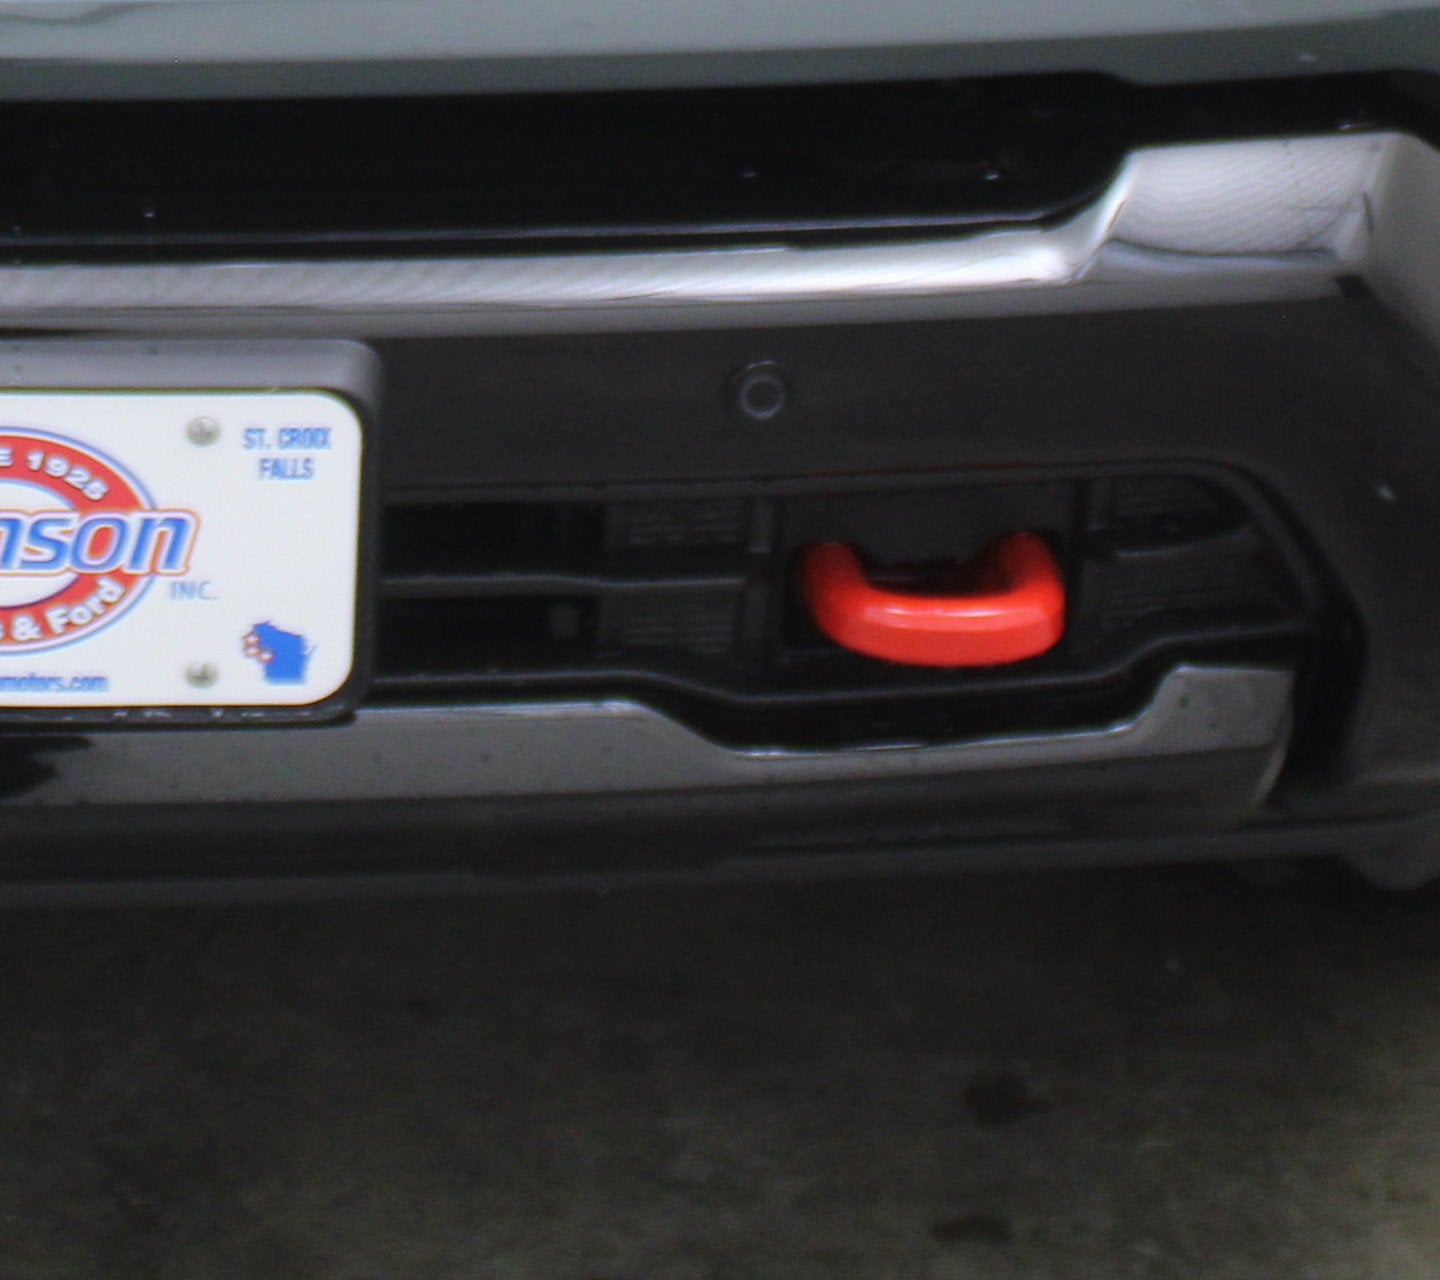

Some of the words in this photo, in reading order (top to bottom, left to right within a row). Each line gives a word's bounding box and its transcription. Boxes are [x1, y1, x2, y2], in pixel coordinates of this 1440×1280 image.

[243, 428, 272, 450] ST.
[278, 428, 332, 450] CROIX
[26, 451, 110, 502] 1925
[259, 458, 314, 480] FALLS
[170, 581, 218, 601] INC.
[13, 616, 41, 641] &
[48, 578, 125, 635] Ford
